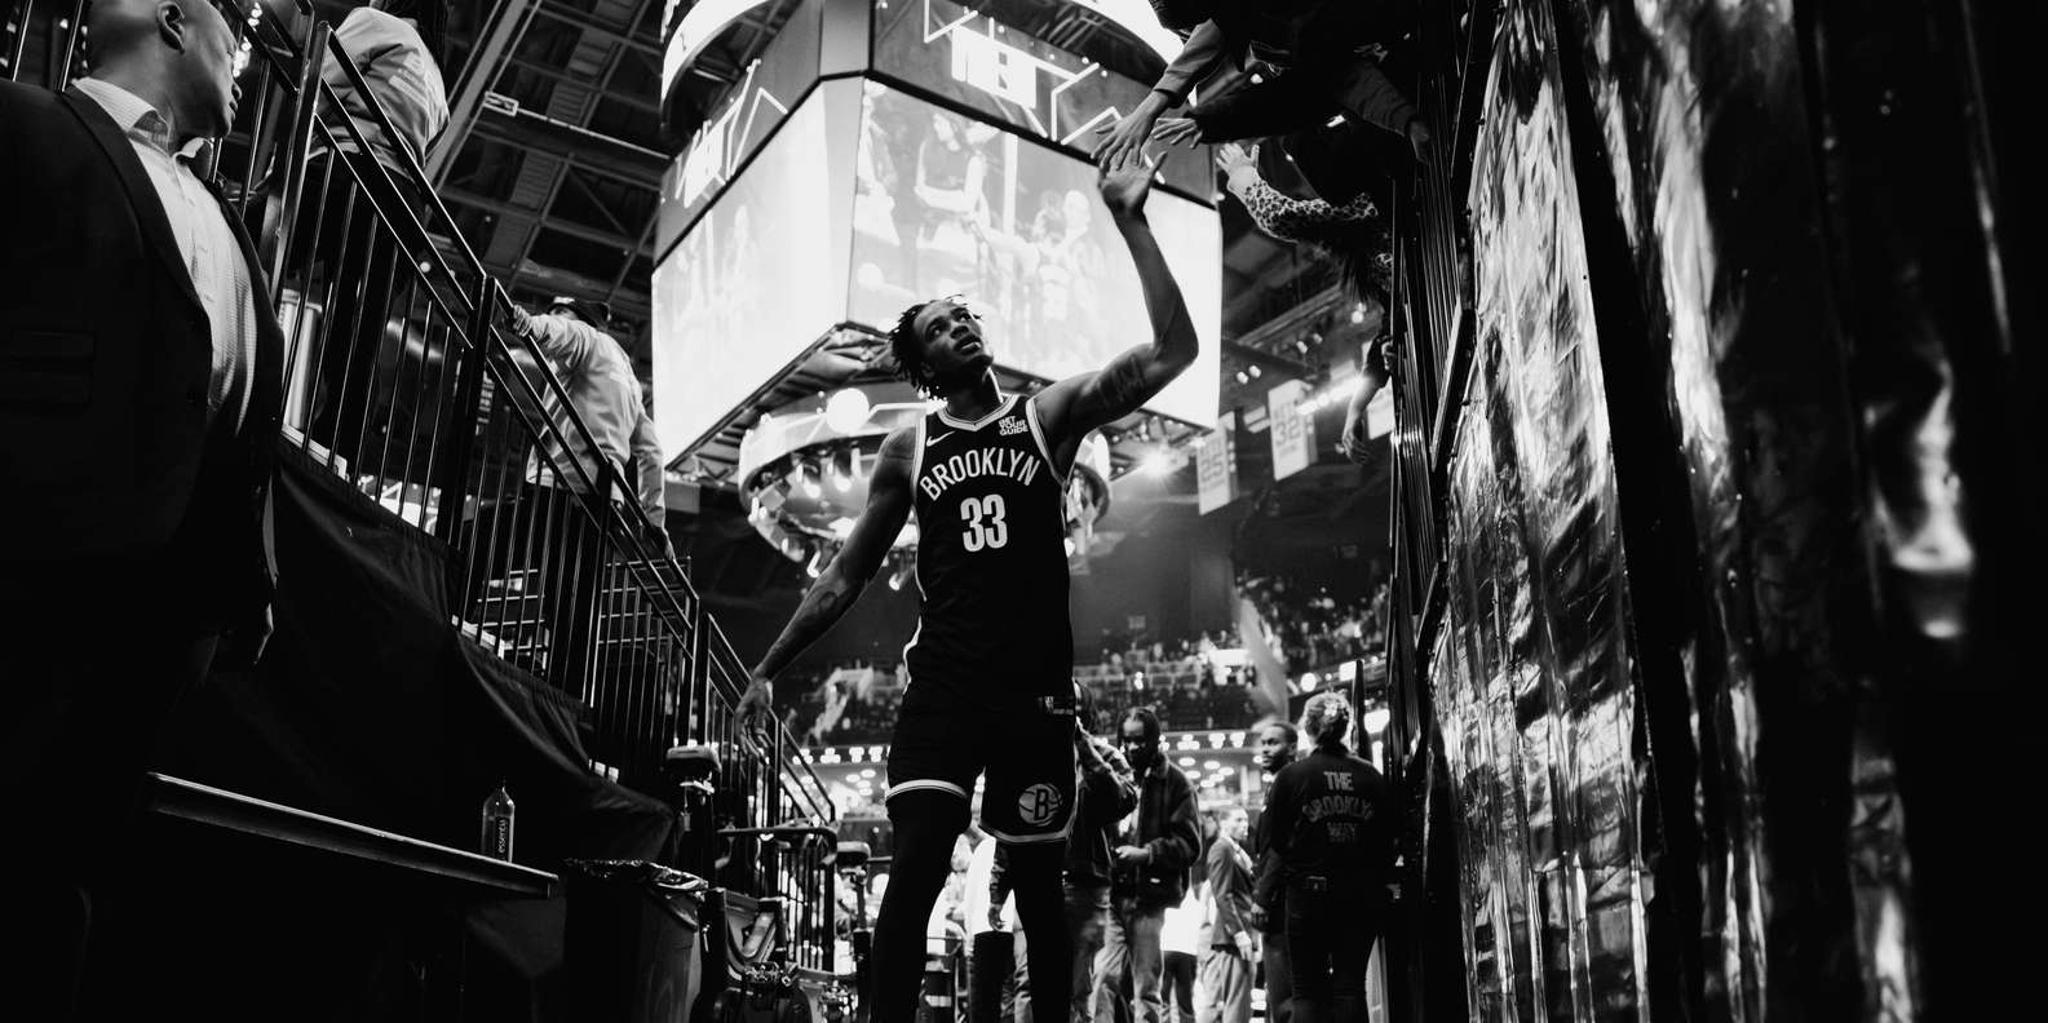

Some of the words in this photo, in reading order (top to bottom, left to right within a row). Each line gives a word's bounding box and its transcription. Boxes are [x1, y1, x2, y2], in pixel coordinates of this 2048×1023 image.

[1275, 414, 1301, 447] 32
[919, 447, 1041, 501] BROOKLYN
[960, 494, 1008, 552] 33
[1323, 770, 1354, 791] THE
